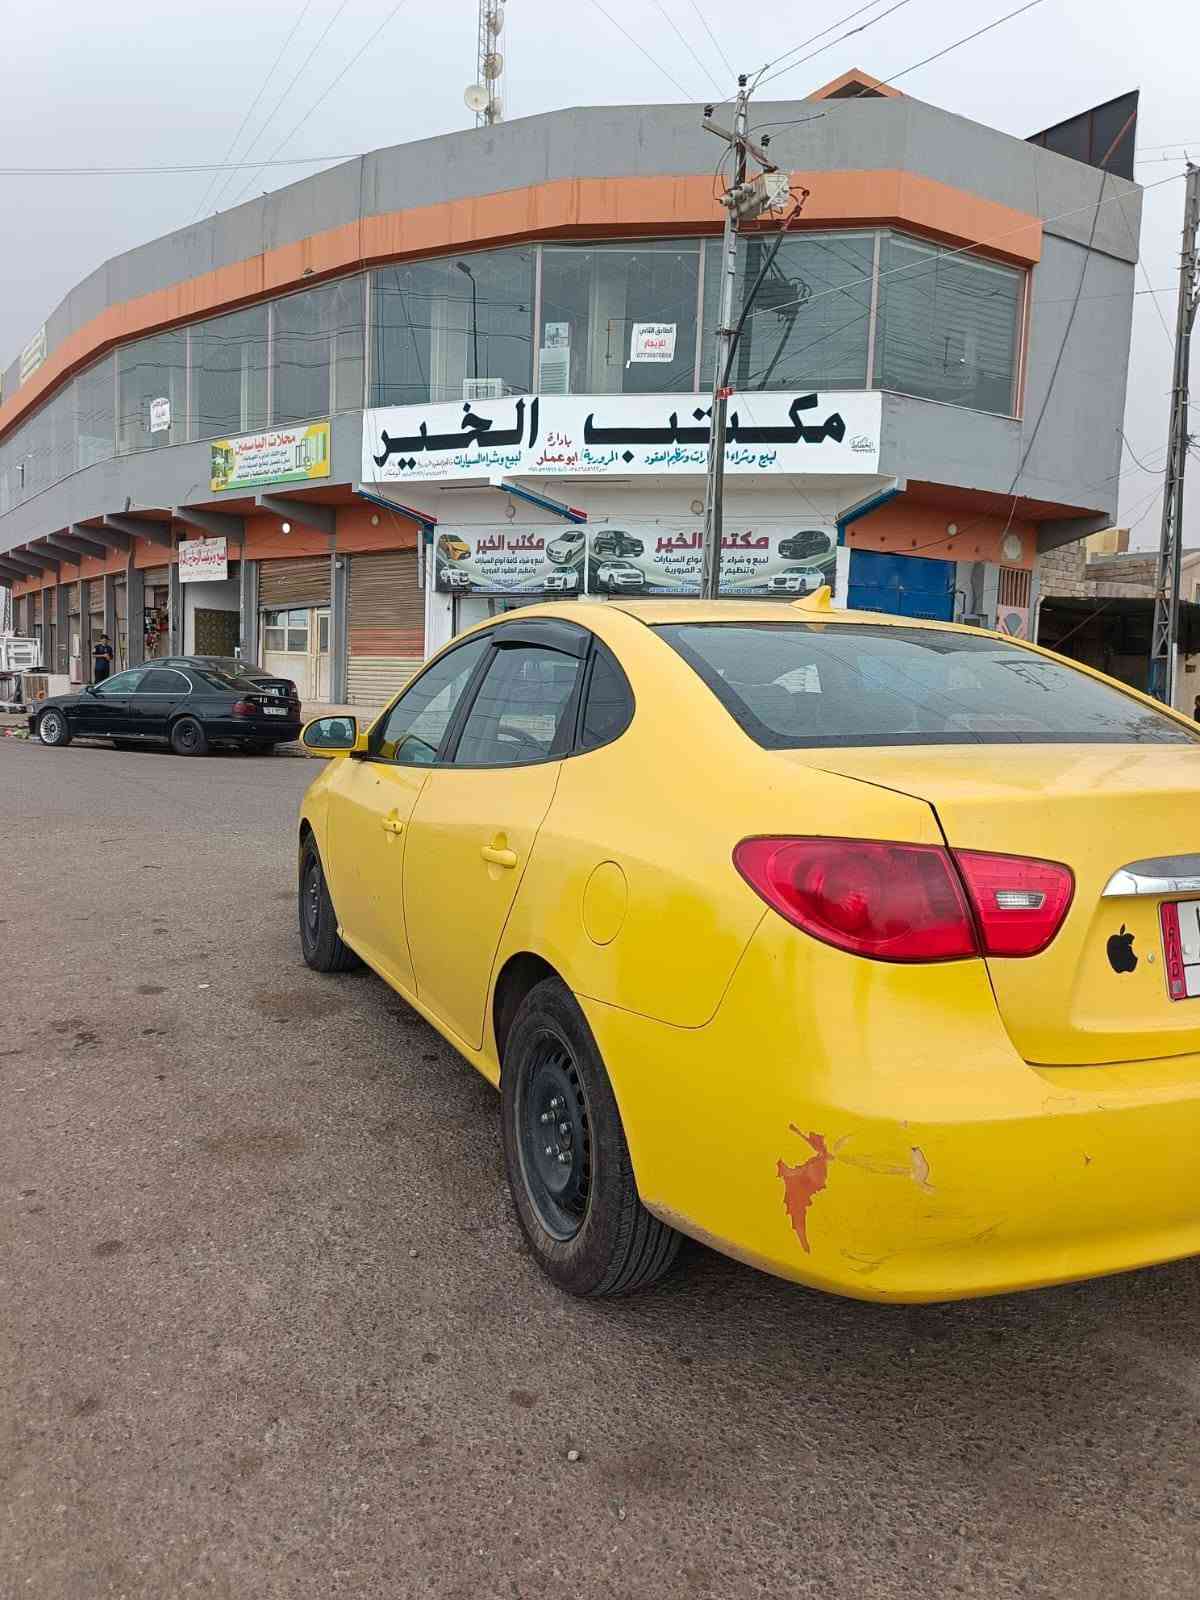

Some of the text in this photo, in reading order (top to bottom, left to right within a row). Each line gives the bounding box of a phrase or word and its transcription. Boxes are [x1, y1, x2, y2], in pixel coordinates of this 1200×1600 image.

[373, 393, 846, 468] مكتب الخير
[505, 451, 521, 469] لبيع
[644, 449, 669, 467] العقود
[758, 450, 777, 468] لبيع
[476, 533, 544, 554] مكتب الخير
[655, 531, 704, 554] الخير
[752, 555, 769, 565] لبيع
